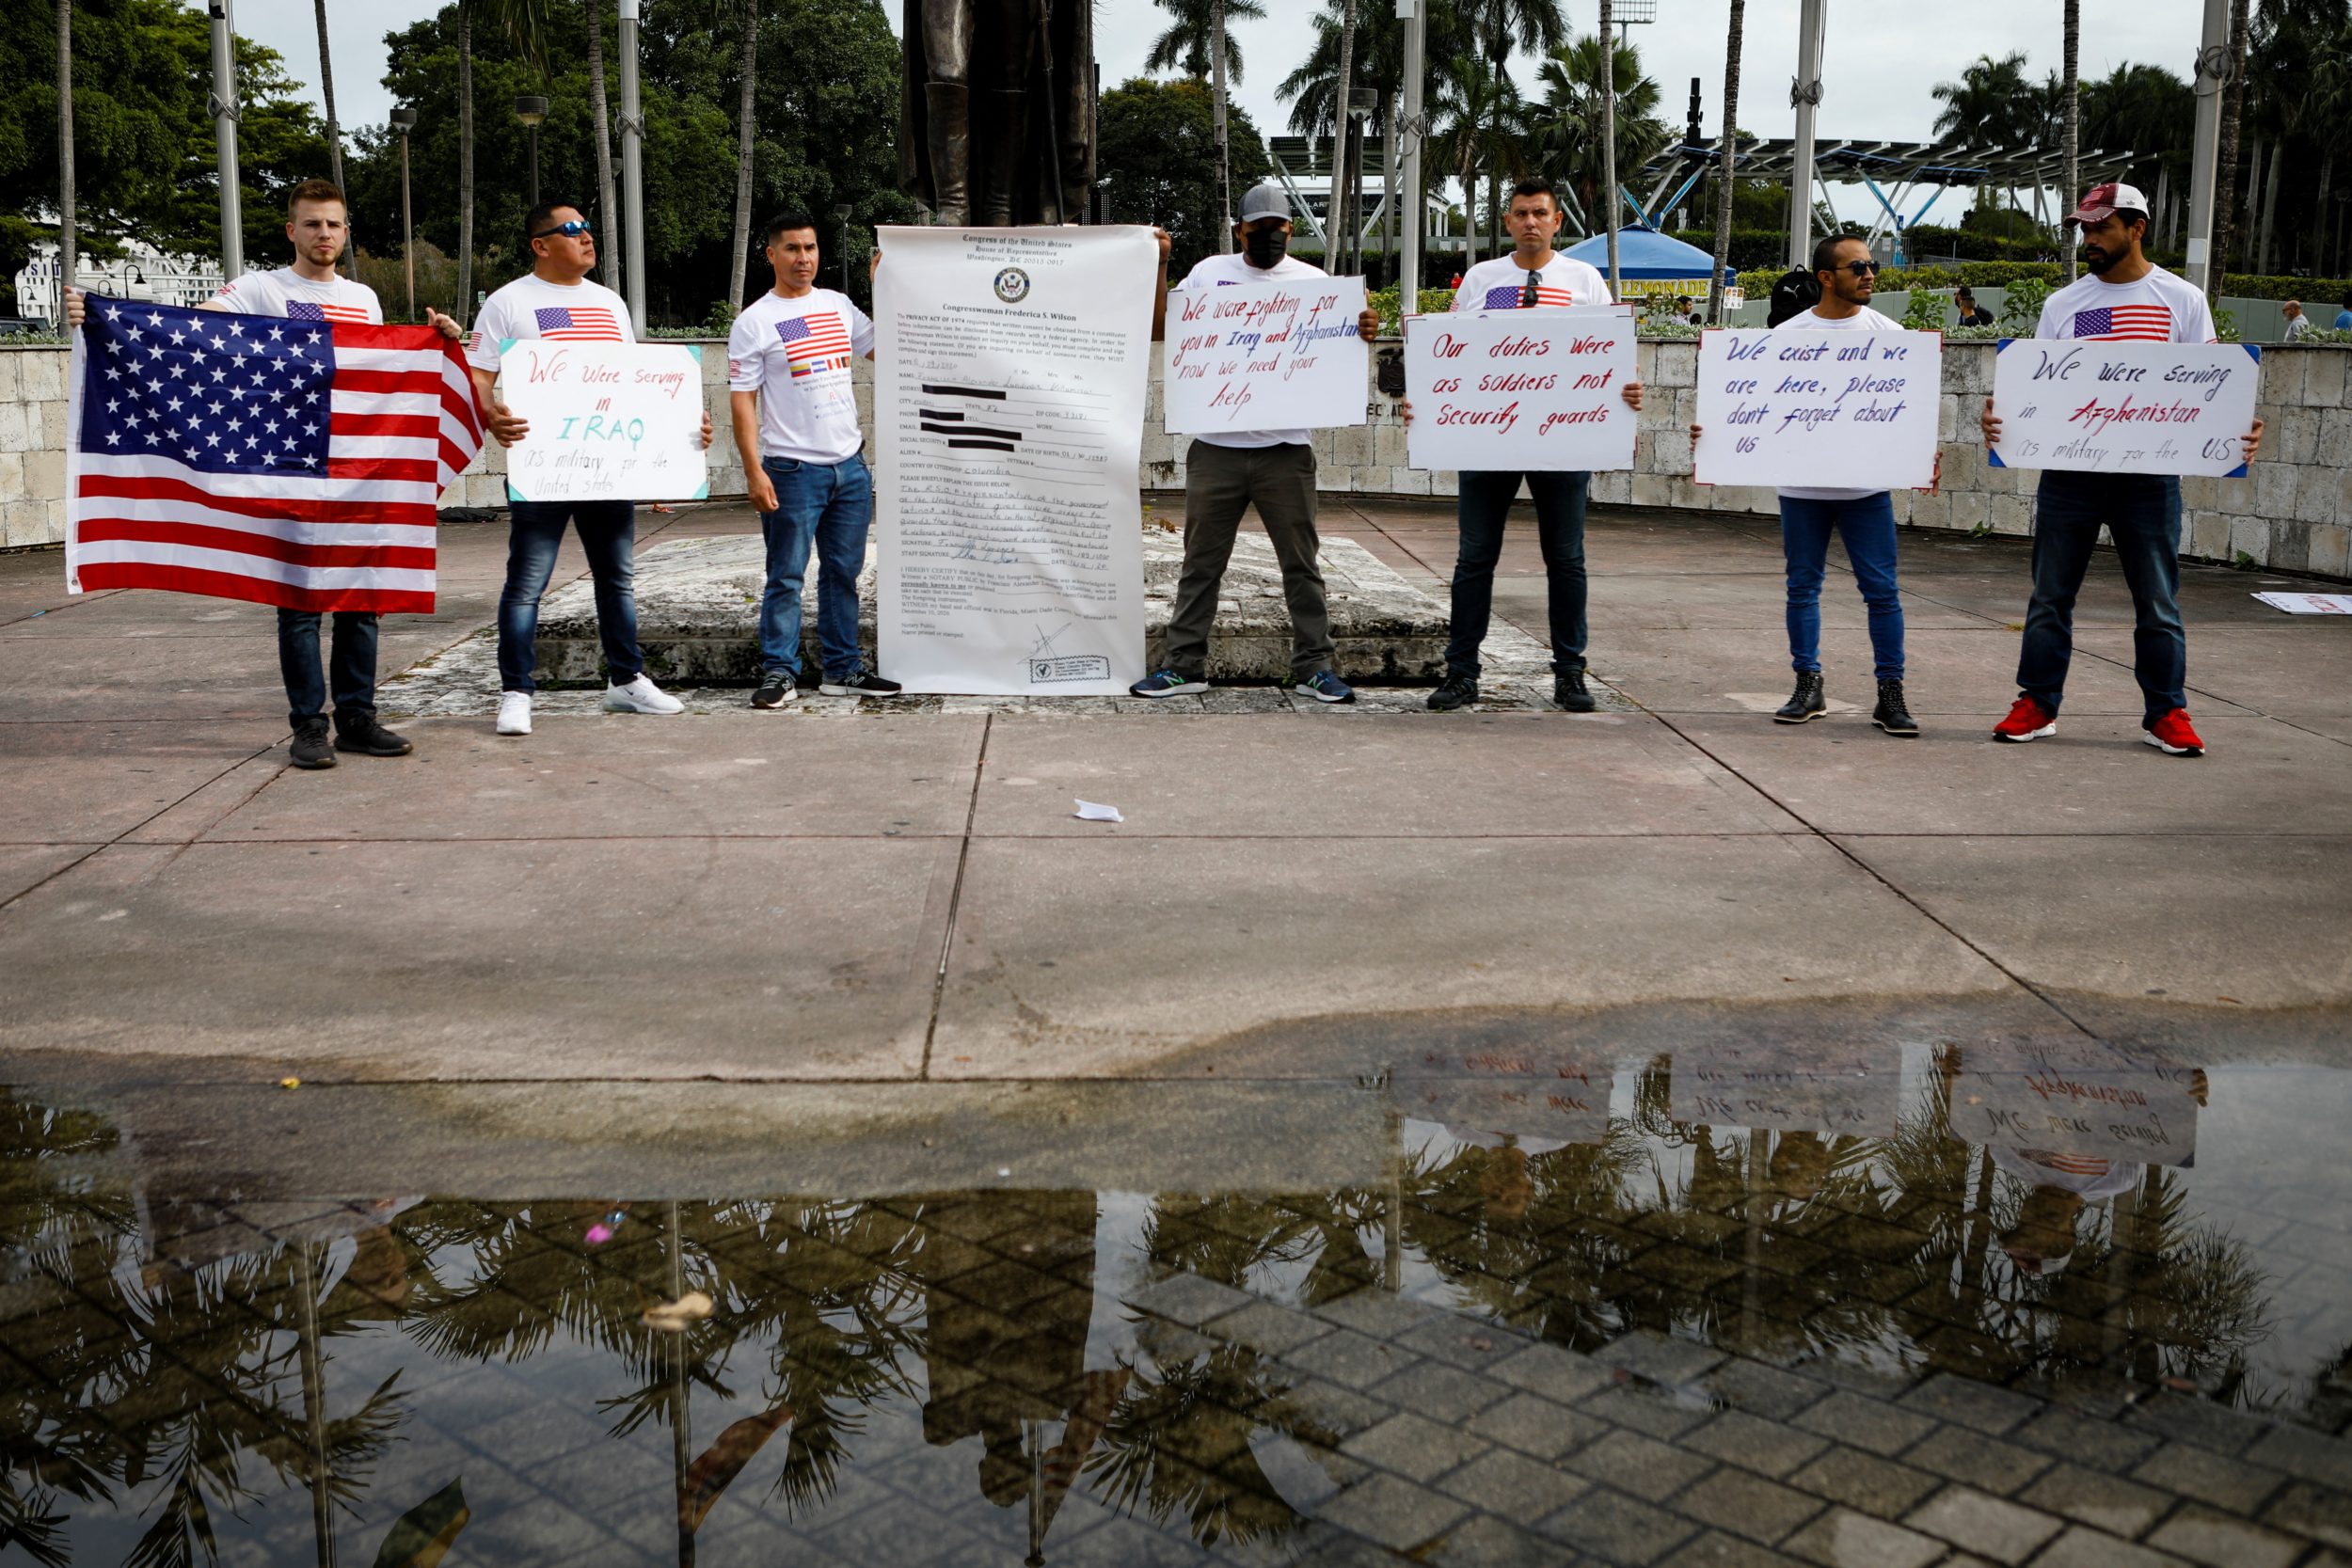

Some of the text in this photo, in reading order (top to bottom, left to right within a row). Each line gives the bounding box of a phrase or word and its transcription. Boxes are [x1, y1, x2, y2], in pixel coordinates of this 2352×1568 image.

[962, 234, 997, 244] Congress
[1021, 238, 1045, 246] United
[1622, 279, 1708, 295] LEMONADE
[943, 304, 1003, 315] Congresswoman
[1005, 309, 1041, 318] Frederica
[1051, 312, 1076, 322] Wilson
[1182, 293, 1208, 321] We
[1244, 292, 1301, 327] fighting
[1308, 294, 1339, 325] for
[1173, 337, 1200, 367] you
[1204, 334, 1218, 348] in
[1227, 331, 1261, 358] Iraq
[1265, 328, 1291, 343] and
[1433, 334, 1469, 358] Our
[1489, 336, 1550, 357] duties
[1726, 335, 1908, 362] We exist and we
[529, 349, 569, 384] We
[1178, 362, 1210, 380] now
[1247, 352, 1280, 372] need
[1283, 356, 1317, 381] your
[2032, 347, 2083, 380] We
[1432, 368, 1613, 393] as soldiers not
[1725, 374, 1906, 404] are here, please
[596, 396, 611, 412] in
[1208, 382, 1251, 421] help
[2019, 393, 2200, 436] in Afghanistan
[1539, 404, 1610, 436] guards
[1727, 399, 1906, 435] don't forget about
[557, 416, 644, 451] IRAQ
[555, 449, 605, 469] military
[652, 451, 668, 468] the
[2053, 436, 2109, 468] military
[2154, 439, 2179, 459] the
[534, 477, 569, 495] United
